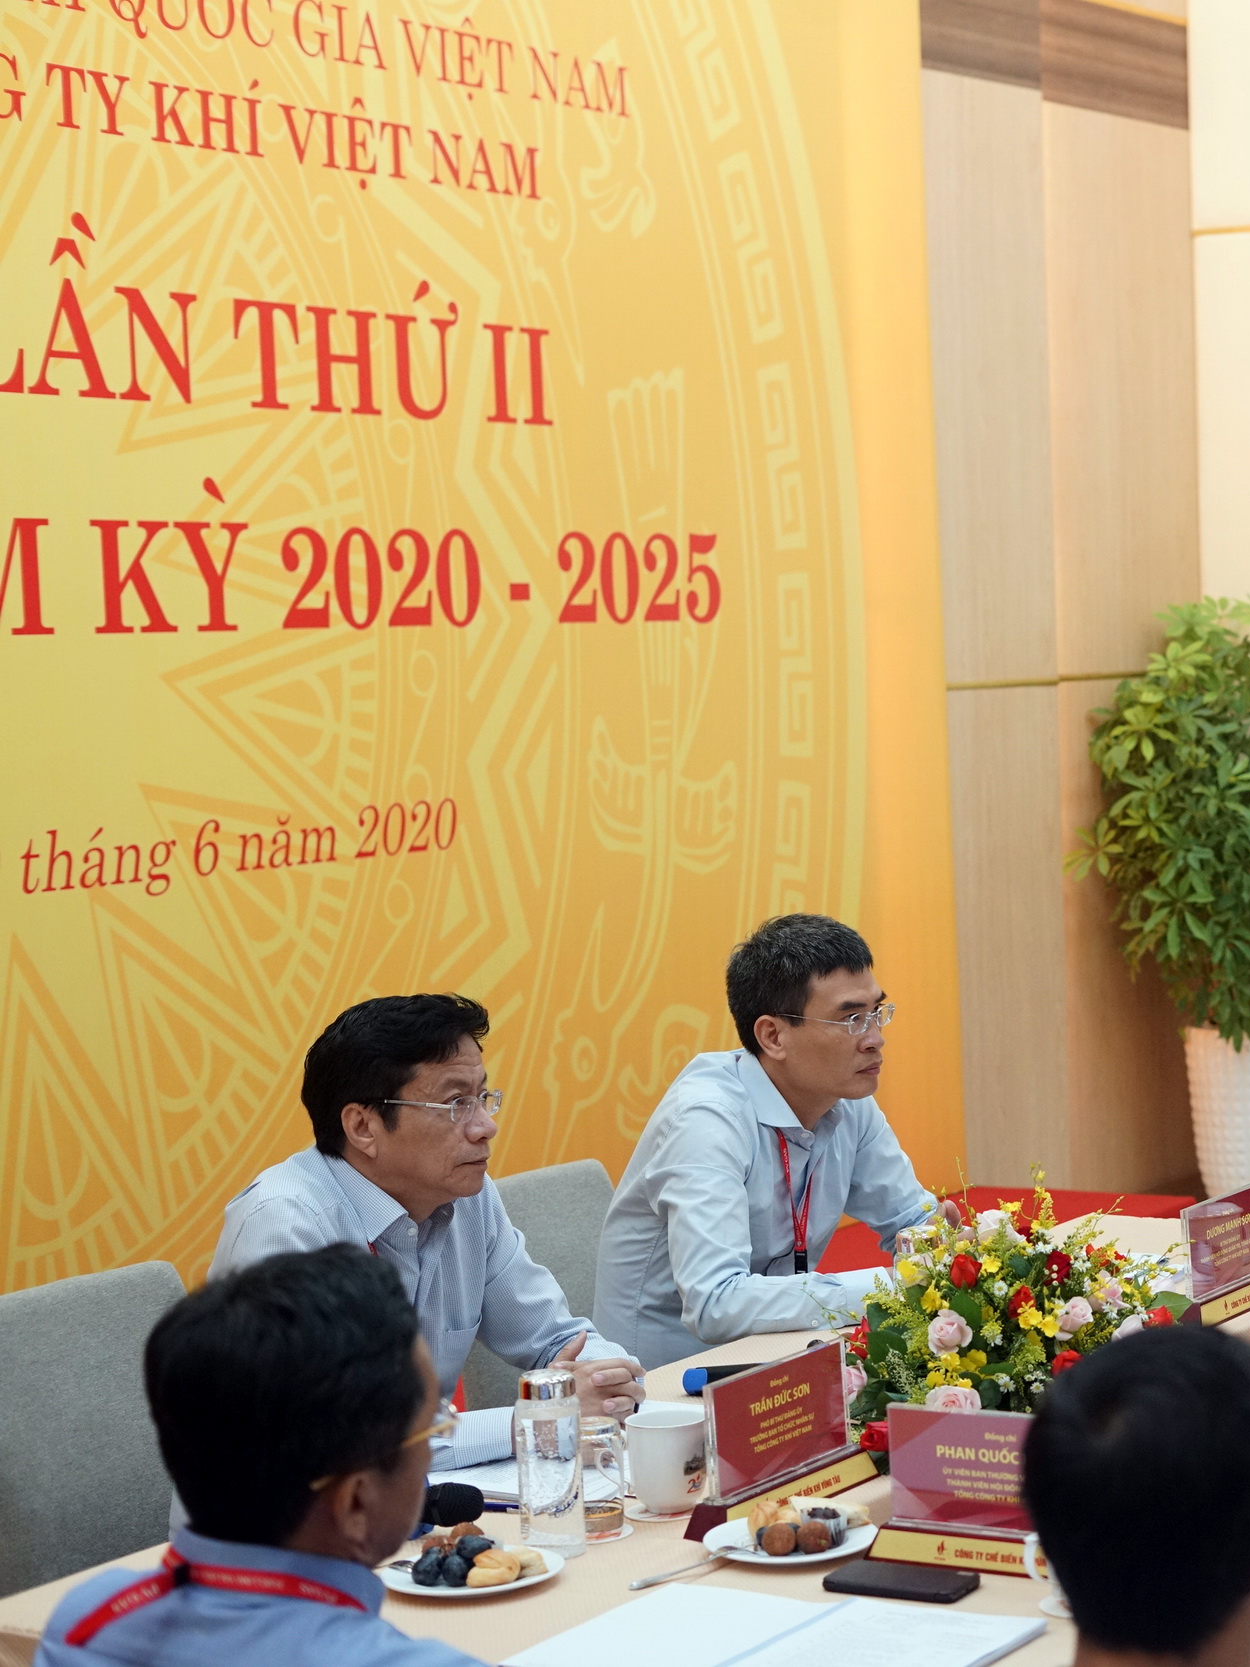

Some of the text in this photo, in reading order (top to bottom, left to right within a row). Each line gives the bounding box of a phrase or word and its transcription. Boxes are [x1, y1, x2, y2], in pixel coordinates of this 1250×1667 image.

[292, 0, 388, 71] GIA
[399, 16, 515, 101] VIỆT
[528, 46, 631, 118] NAM
[46, 62, 130, 137] TY
[149, 79, 264, 158] KHÍ
[277, 97, 412, 190] VIỆT
[428, 129, 542, 201] NAM
[233, 279, 459, 422] THỨ
[483, 324, 554, 427] II
[89, 477, 250, 635] KỲ
[280, 526, 482, 630] 2020
[557, 530, 722, 625] 2025
[20, 797, 458, 897] tháng 6 năm 2020
[774, 1389, 792, 1407] ĐỨC
[793, 1382, 810, 1400] SƠN
[936, 1444, 1020, 1465] PHAN QUỐC
[954, 1548, 974, 1560] CÔNG
[975, 1551, 983, 1560] TY
[985, 1550, 998, 1562] CHẾ
